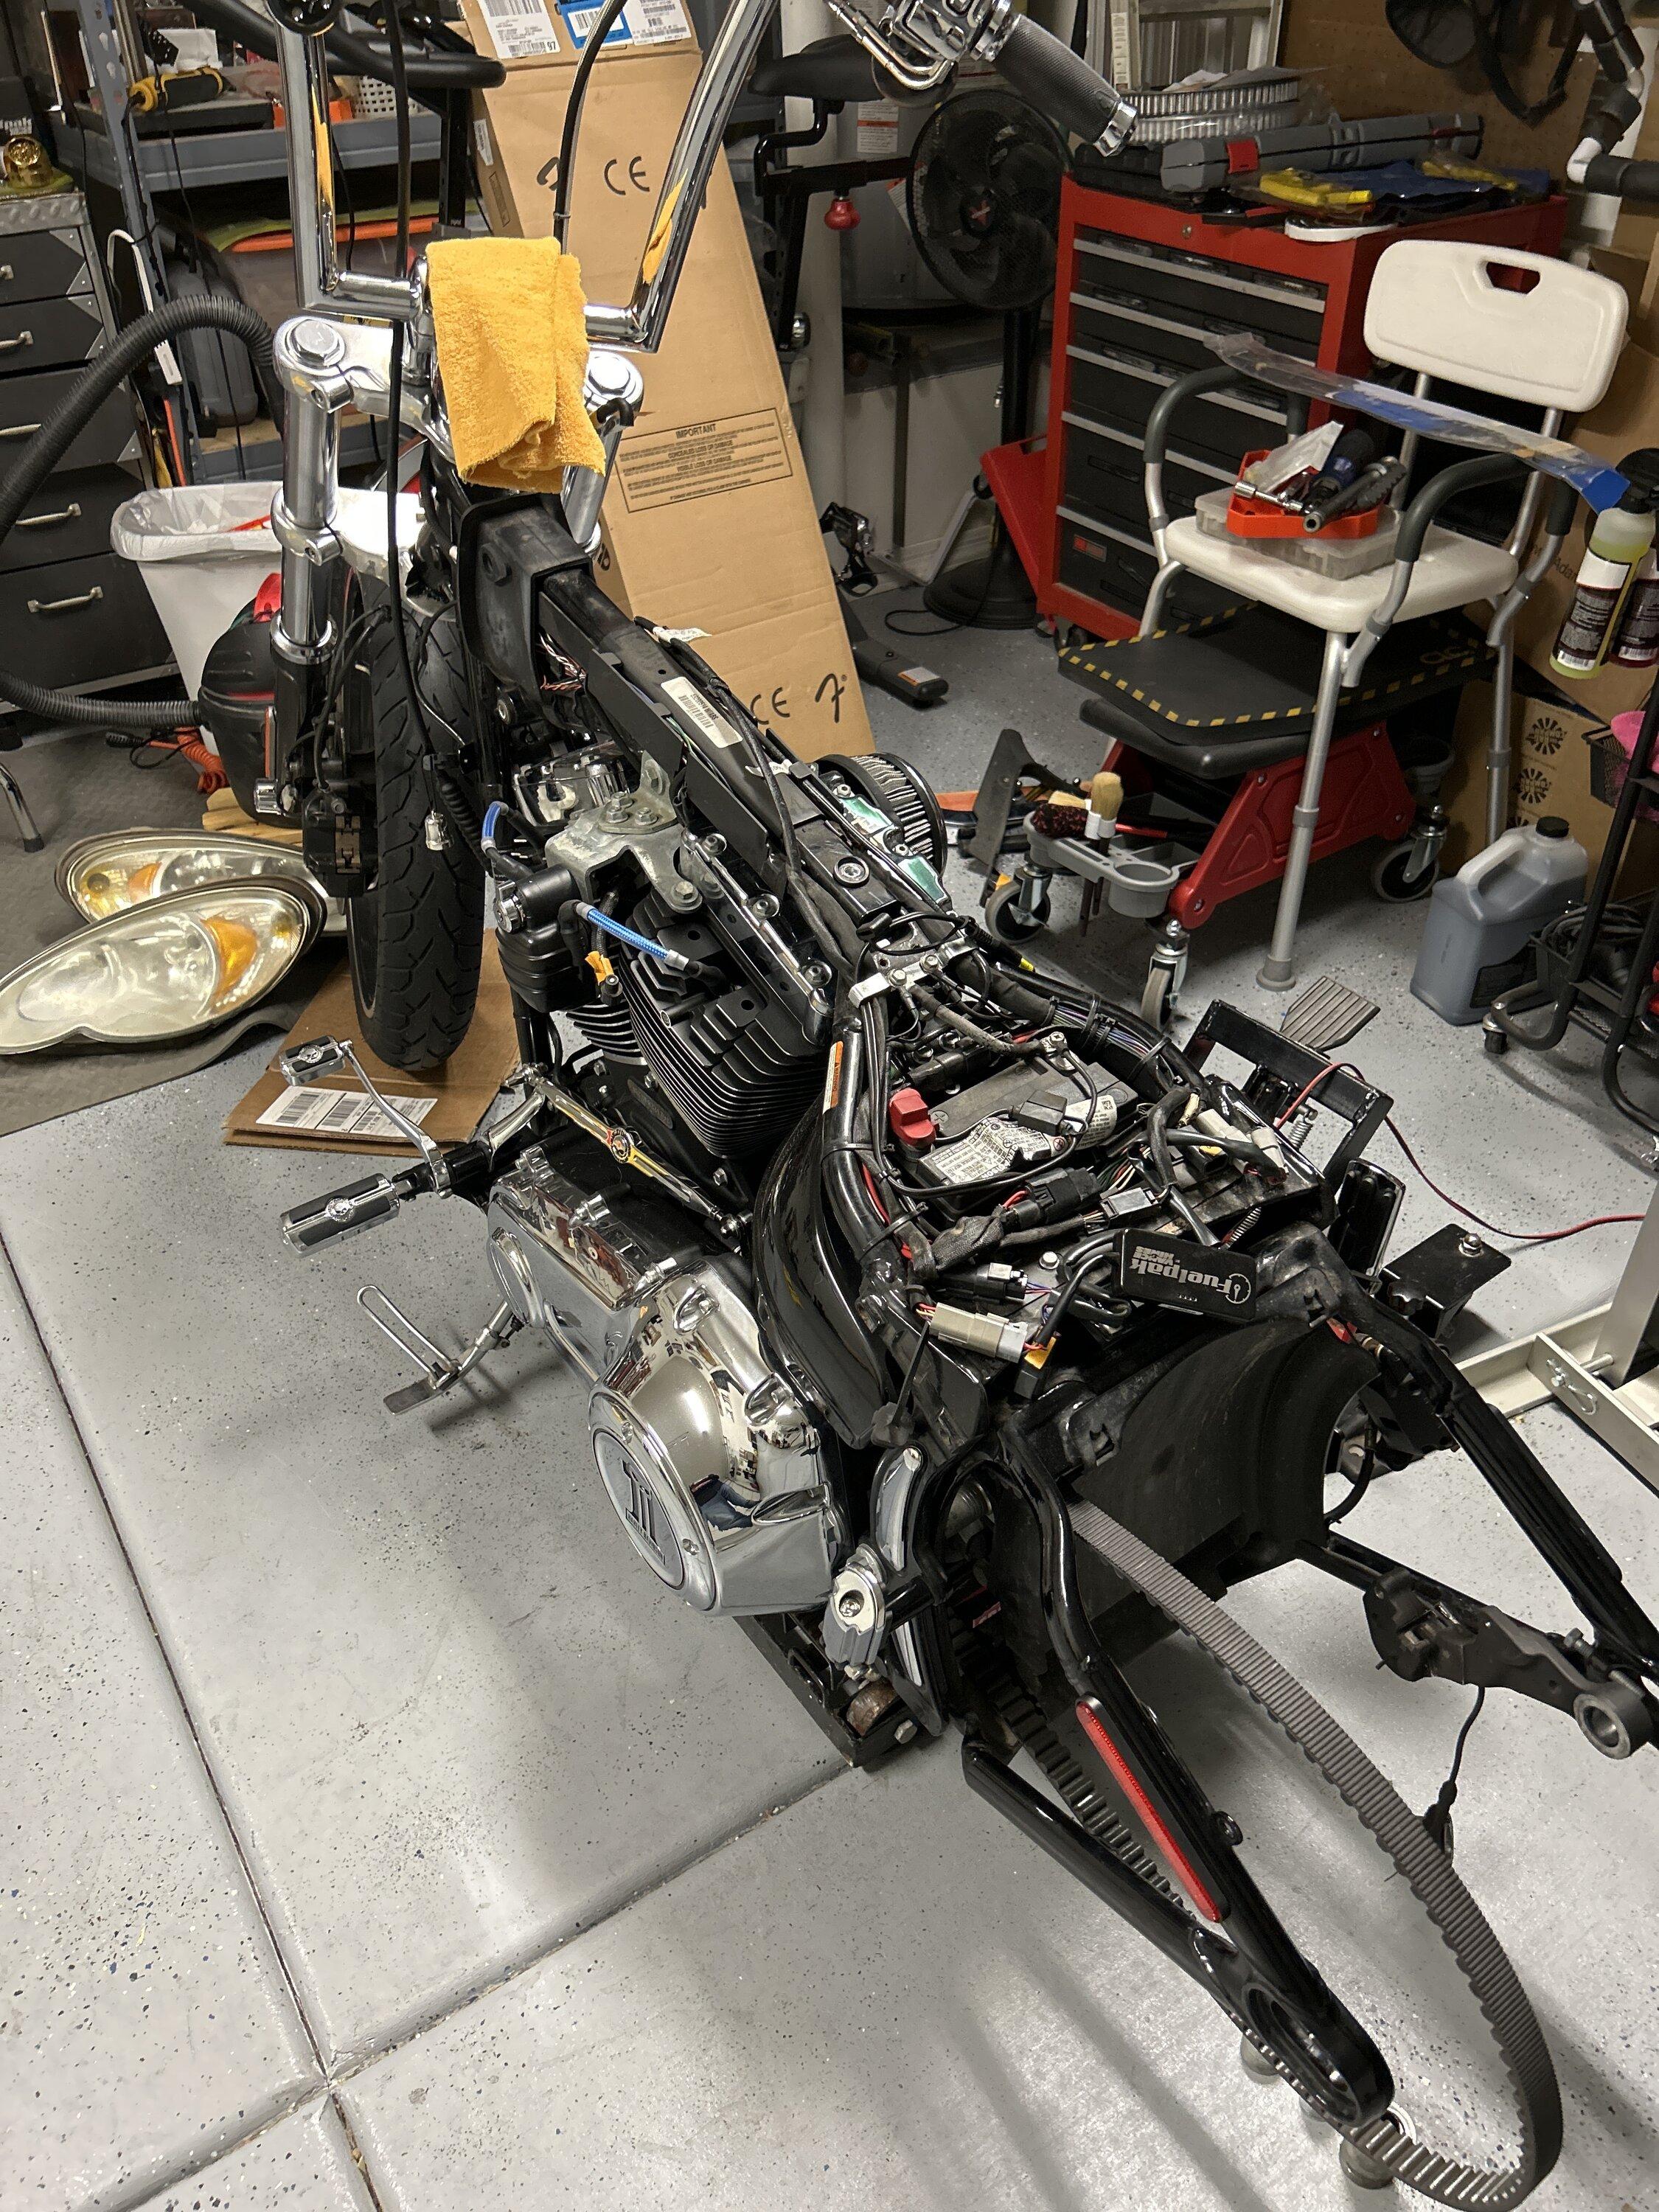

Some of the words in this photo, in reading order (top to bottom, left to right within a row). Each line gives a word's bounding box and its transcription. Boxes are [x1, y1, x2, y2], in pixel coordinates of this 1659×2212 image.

[604, 156, 650, 195] CE
[675, 423, 717, 439] IMPORTANT
[751, 687, 790, 725] CE
[1129, 1257, 1233, 1295] Fuelpak
